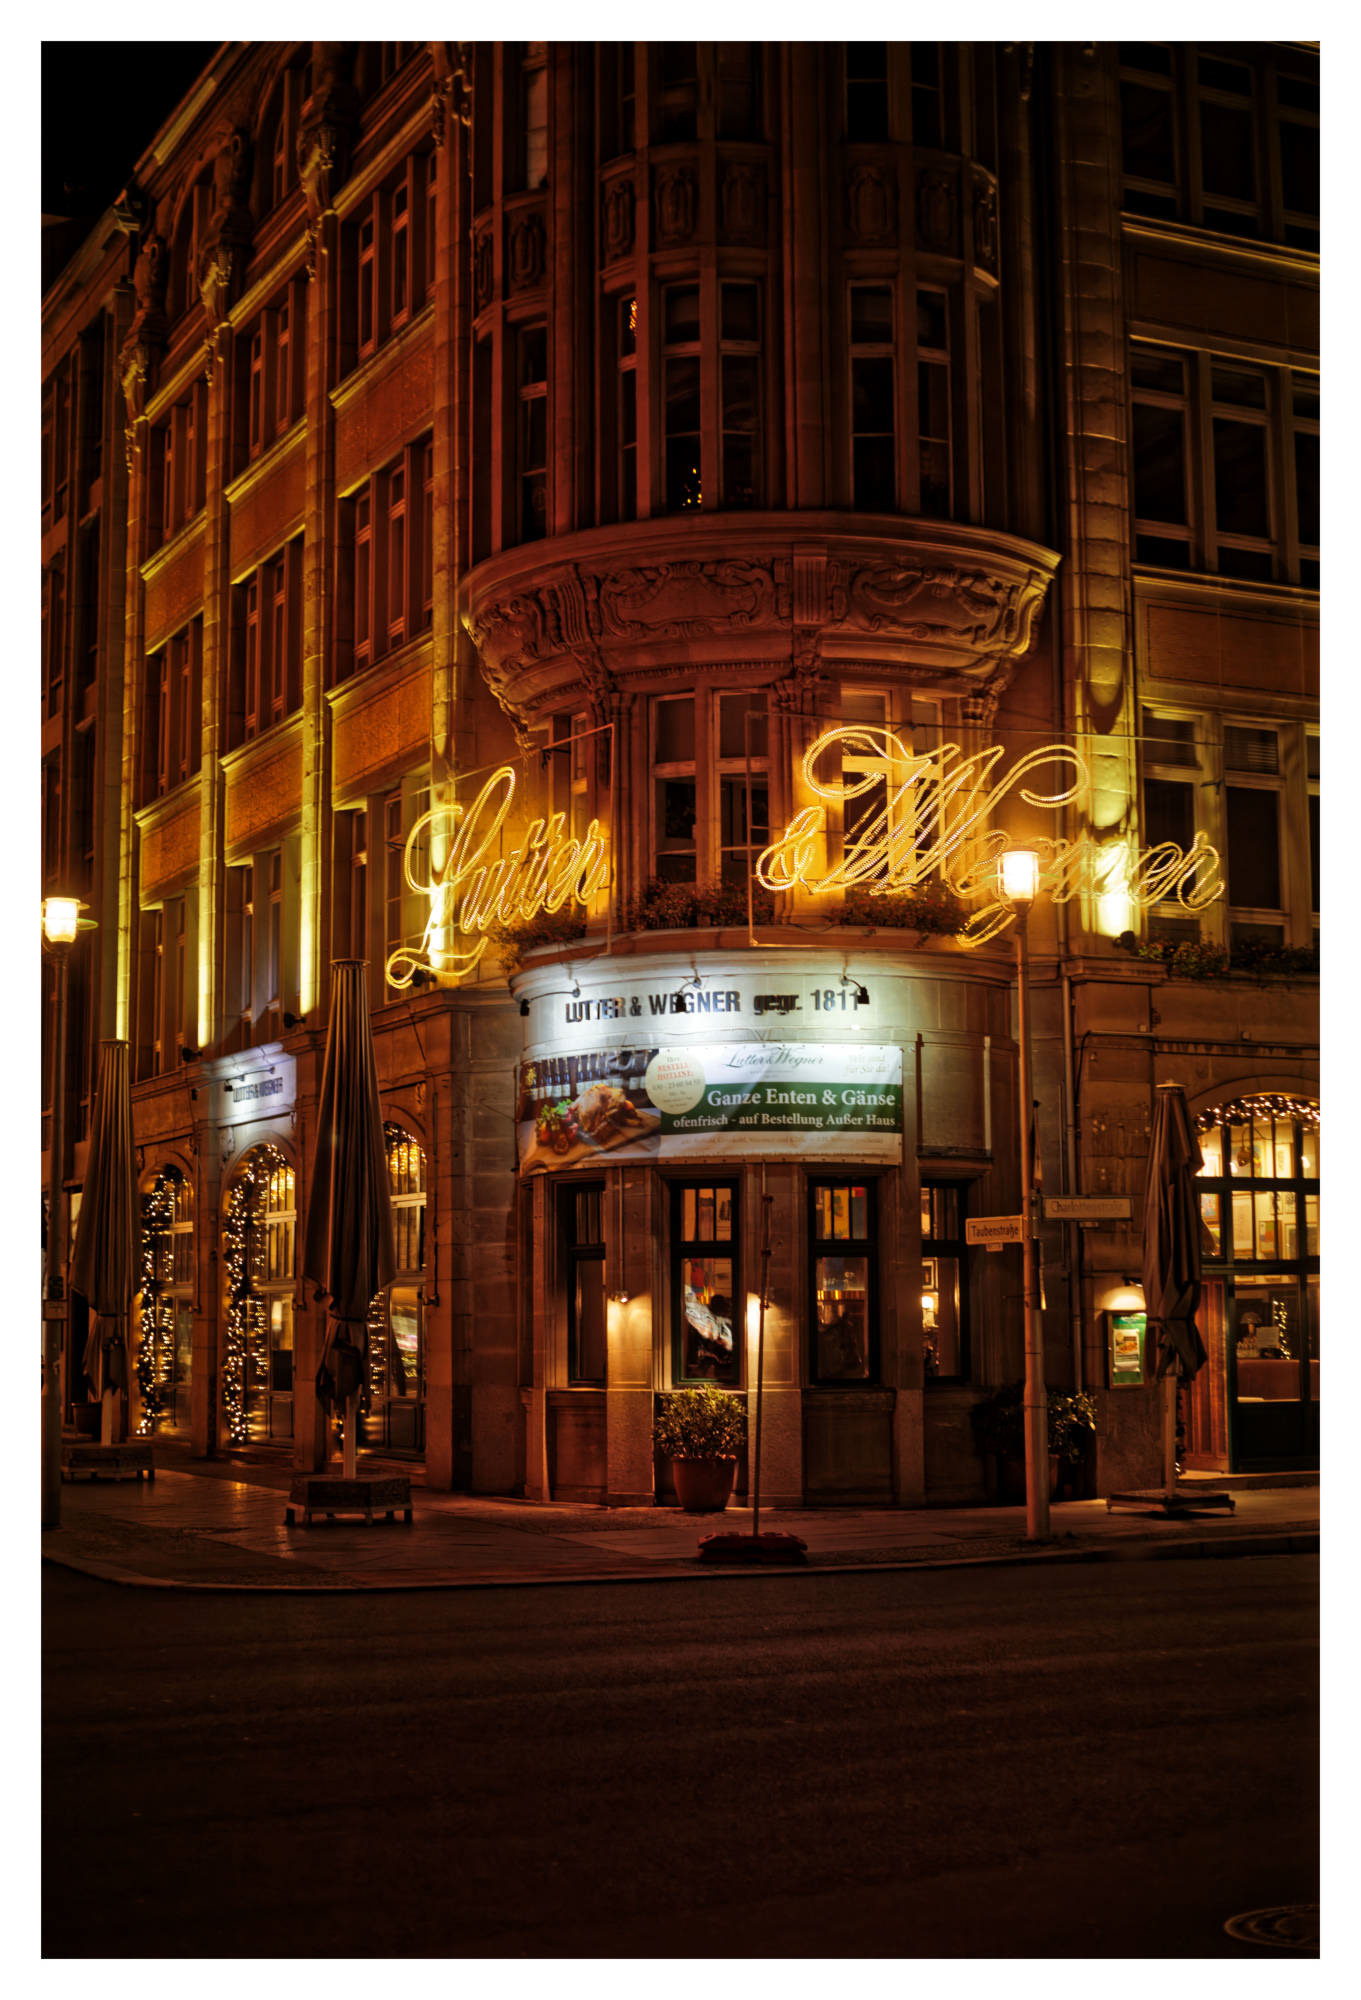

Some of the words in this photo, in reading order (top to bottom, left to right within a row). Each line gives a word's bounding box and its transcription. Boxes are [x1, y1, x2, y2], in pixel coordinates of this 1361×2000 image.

[385, 766, 608, 989] Lutter
[756, 805, 826, 892] &
[565, 996, 626, 1024] LUTTER
[630, 996, 642, 1017] &
[648, 991, 741, 1016] WEGNER
[753, 994, 803, 1016] gegr.
[810, 989, 860, 1011] 1811
[707, 1089, 761, 1107] Ganze
[765, 1087, 817, 1106] Enten
[822, 1089, 837, 1106] &
[841, 1088, 896, 1107] Gänse
[673, 1115, 728, 1128] ofenfrisch
[739, 1113, 758, 1125] auf
[761, 1113, 823, 1128] Bestellung
[826, 1113, 864, 1126] Außer
[866, 1114, 895, 1127] Haus
[971, 1223, 1019, 1239] Taubenstraße
